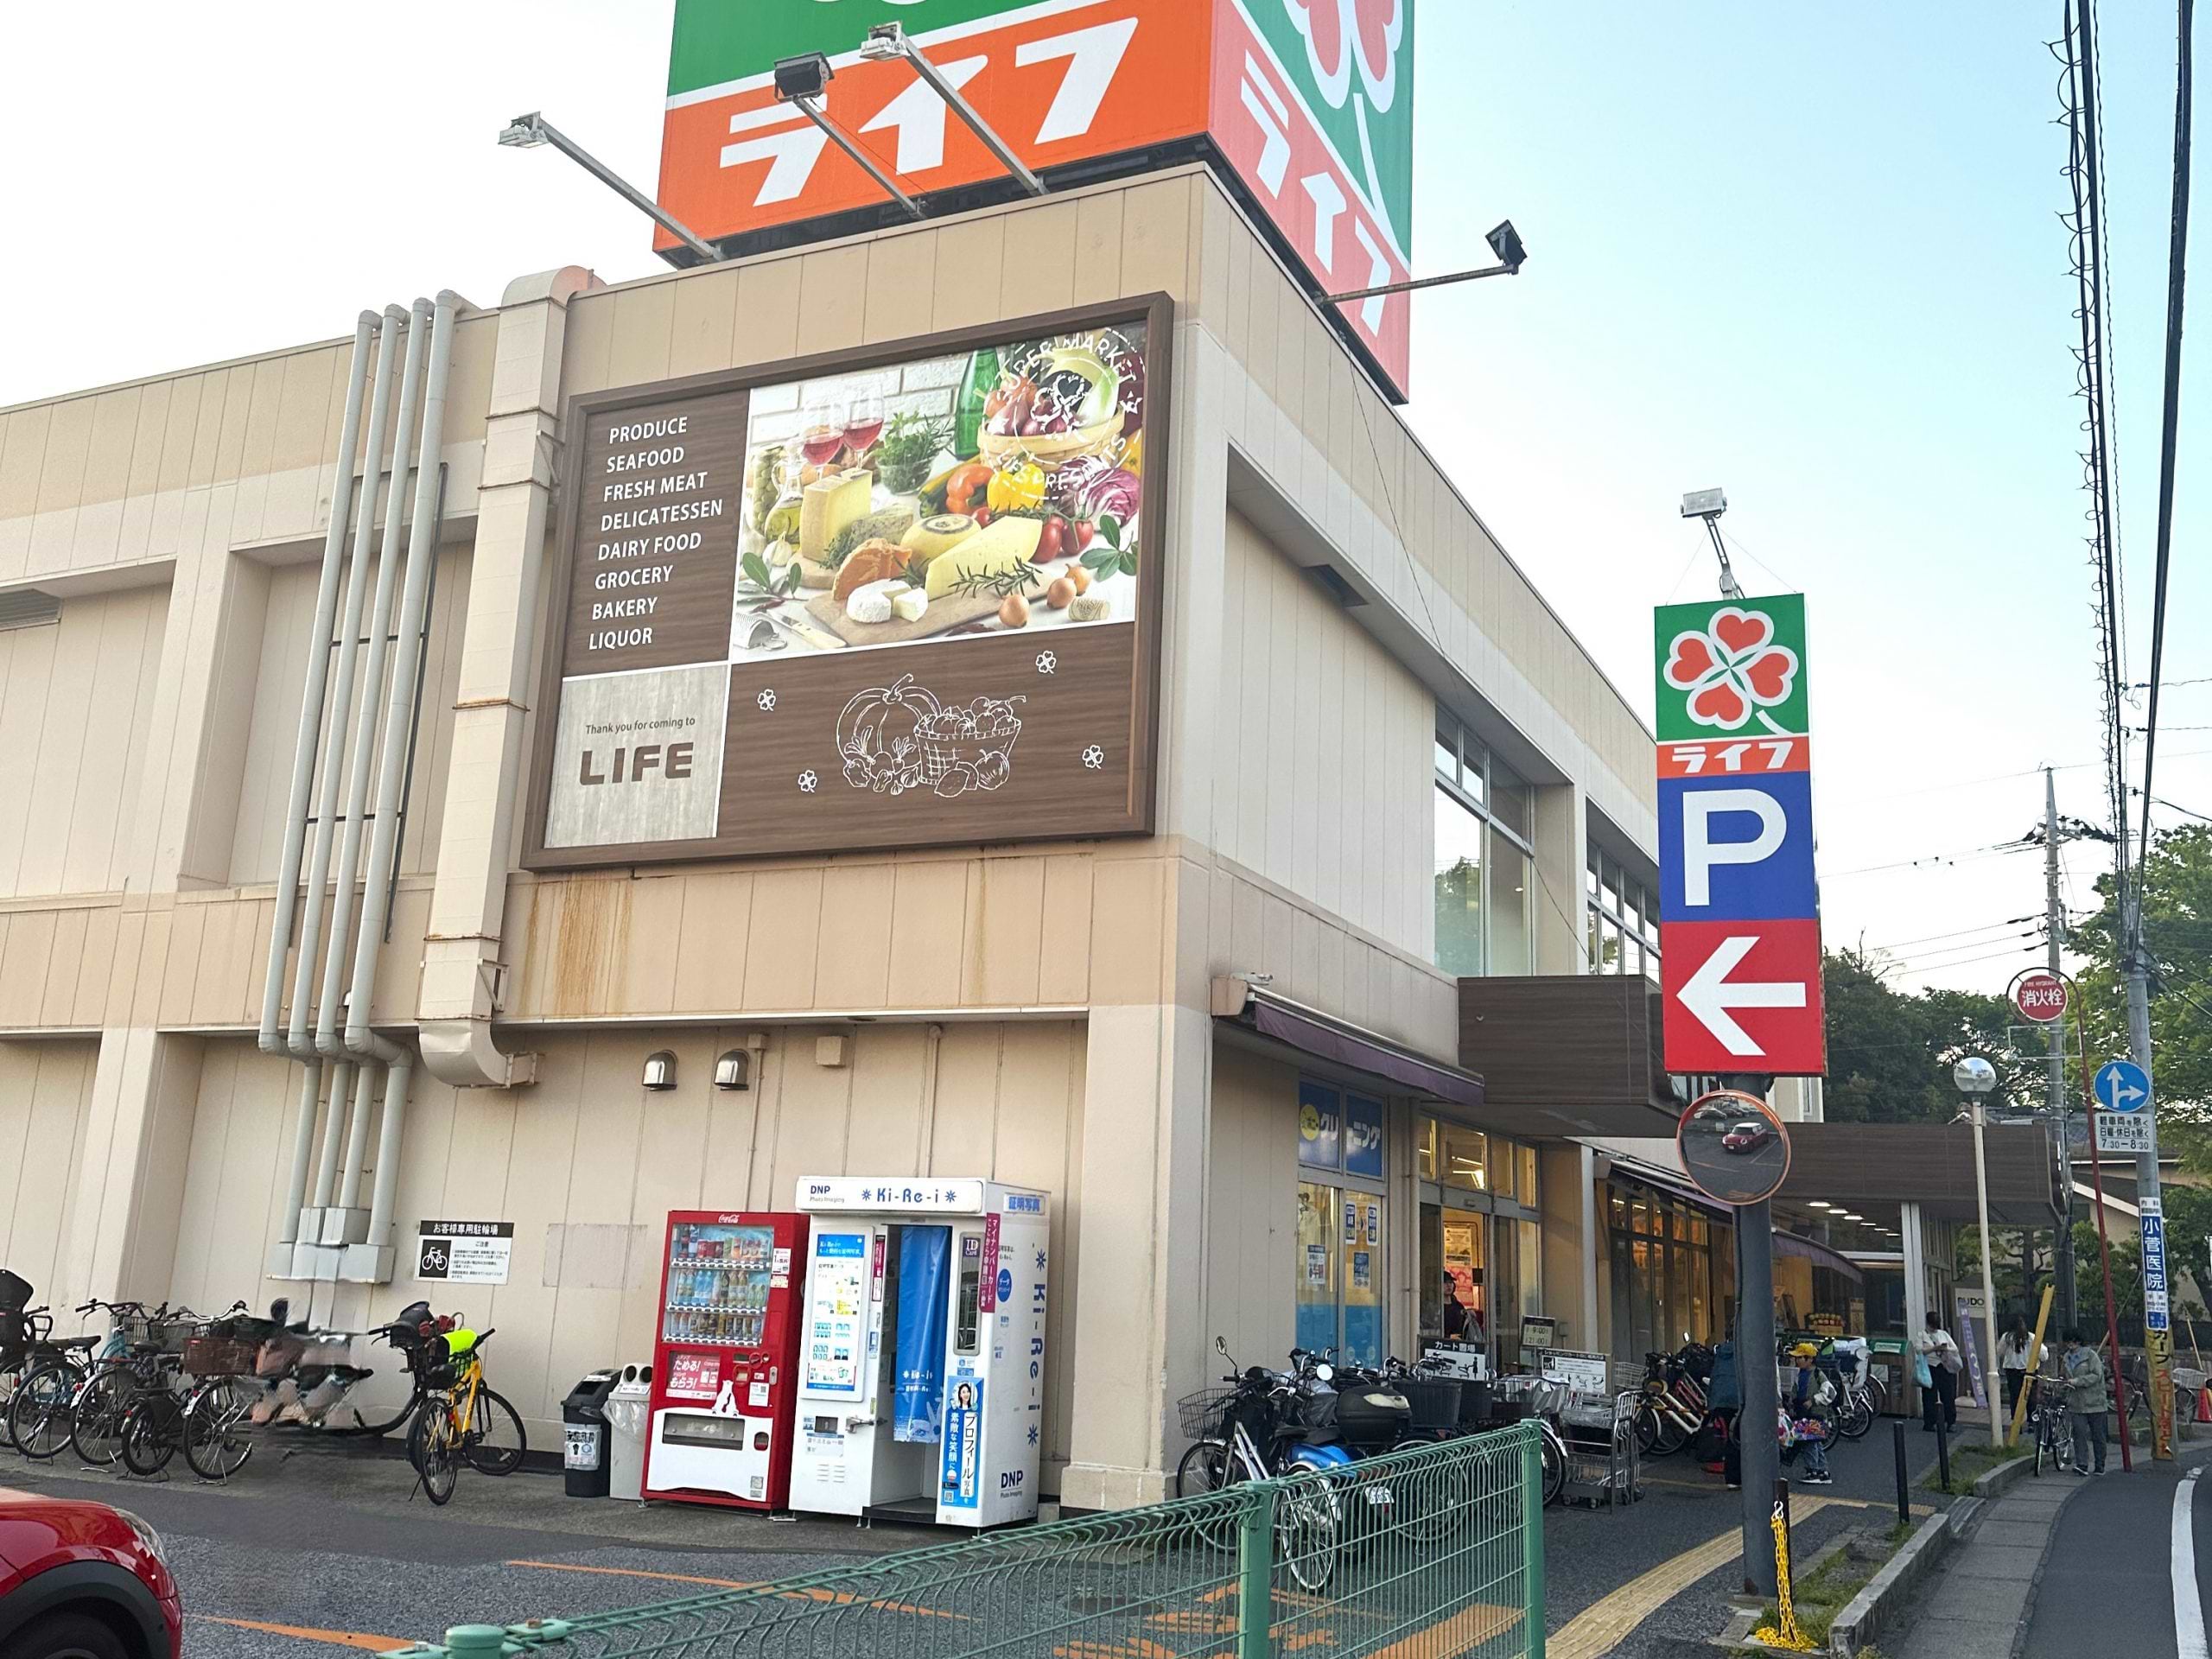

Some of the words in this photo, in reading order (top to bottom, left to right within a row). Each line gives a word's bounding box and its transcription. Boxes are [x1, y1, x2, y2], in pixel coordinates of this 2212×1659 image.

[720, 16, 1140, 207] ライフ
[1240, 48, 1391, 337] ライフ
[1062, 332, 1137, 384] MARKET
[609, 416, 688, 444] PRODUCE
[606, 446, 685, 474] SEAFOOD
[603, 479, 656, 502] FRESH
[659, 471, 708, 494] MEAT
[601, 499, 723, 531] DELICATESSEN
[598, 538, 650, 561] DAIRY
[653, 532, 702, 554] FOOD
[594, 564, 674, 590] GROCERY
[592, 596, 658, 620] BAKERY
[588, 627, 653, 650] LIQUOR
[586, 724, 613, 734] Thank
[614, 724, 632, 734] you
[633, 720, 648, 730] for
[649, 717, 683, 729] coming
[685, 716, 696, 726] to
[579, 741, 694, 786] LIFE
[1671, 741, 1794, 773] ライフ
[1681, 788, 1787, 906] P
[2021, 988, 2064, 1007] 消火栓
[810, 1185, 831, 1194] DNP
[876, 1187, 939, 1204] Ki-Re-i
[1008, 1196, 1040, 1212] 証明写真
[433, 1223, 499, 1236] お客様専用駐輪場
[965, 1239, 978, 1250] ID
[2144, 1218, 2164, 1289] 小菅医院
[988, 1219, 998, 1305] マイナンバーカード
[1001, 1470, 1024, 1489] DNP
